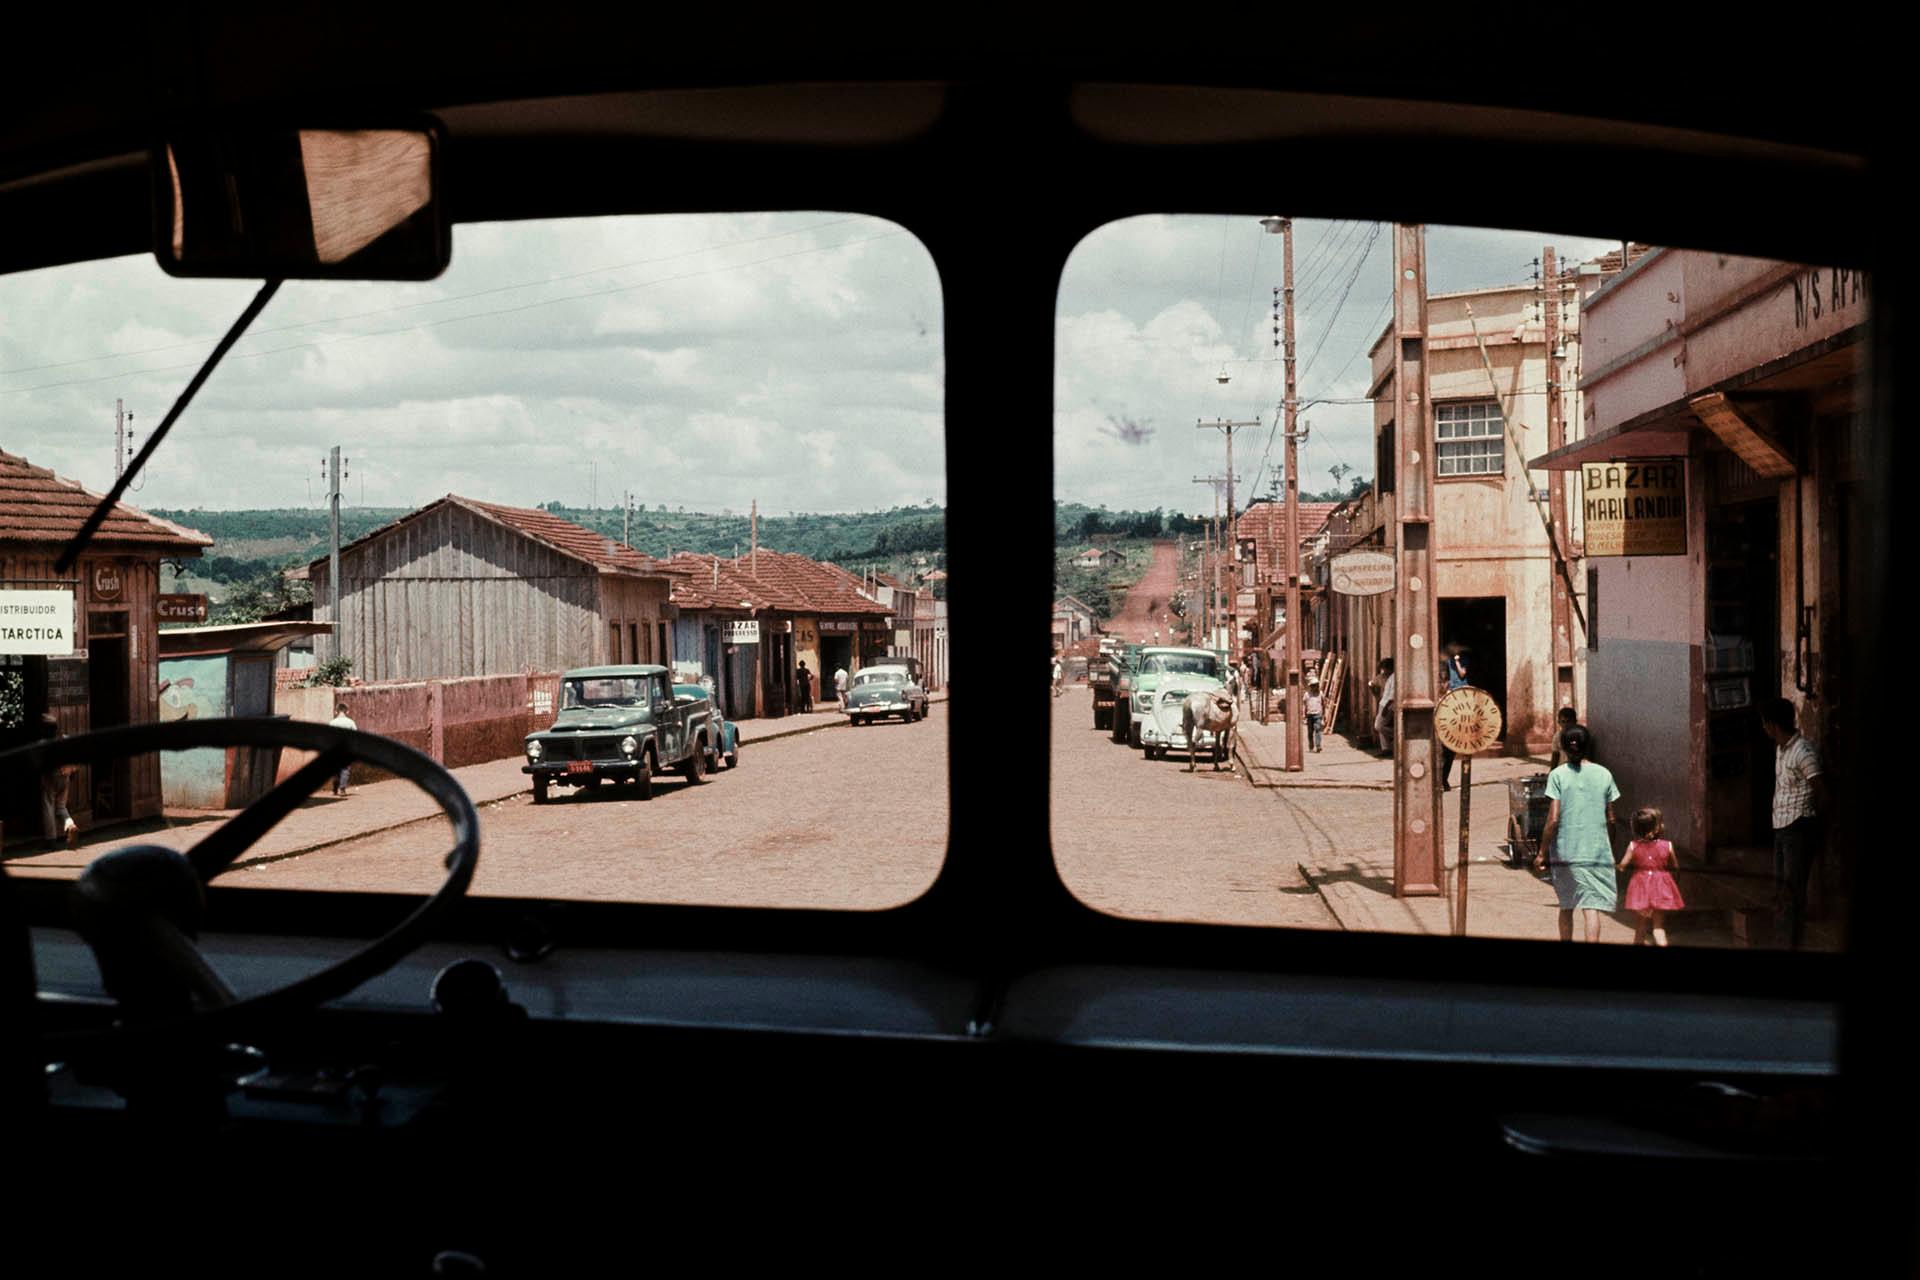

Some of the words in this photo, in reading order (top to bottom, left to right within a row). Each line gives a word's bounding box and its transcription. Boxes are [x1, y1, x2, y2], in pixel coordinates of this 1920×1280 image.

[1832, 267, 1872, 312] APA
[1587, 465, 1678, 491] BAZAR
[1586, 496, 1682, 520] MARILANDIA
[95, 567, 120, 592] Crush
[157, 599, 206, 617] Crush
[1, 628, 64, 640] TARCTICA
[724, 622, 757, 630] BAZAR
[1452, 700, 1485, 716] PONTO
